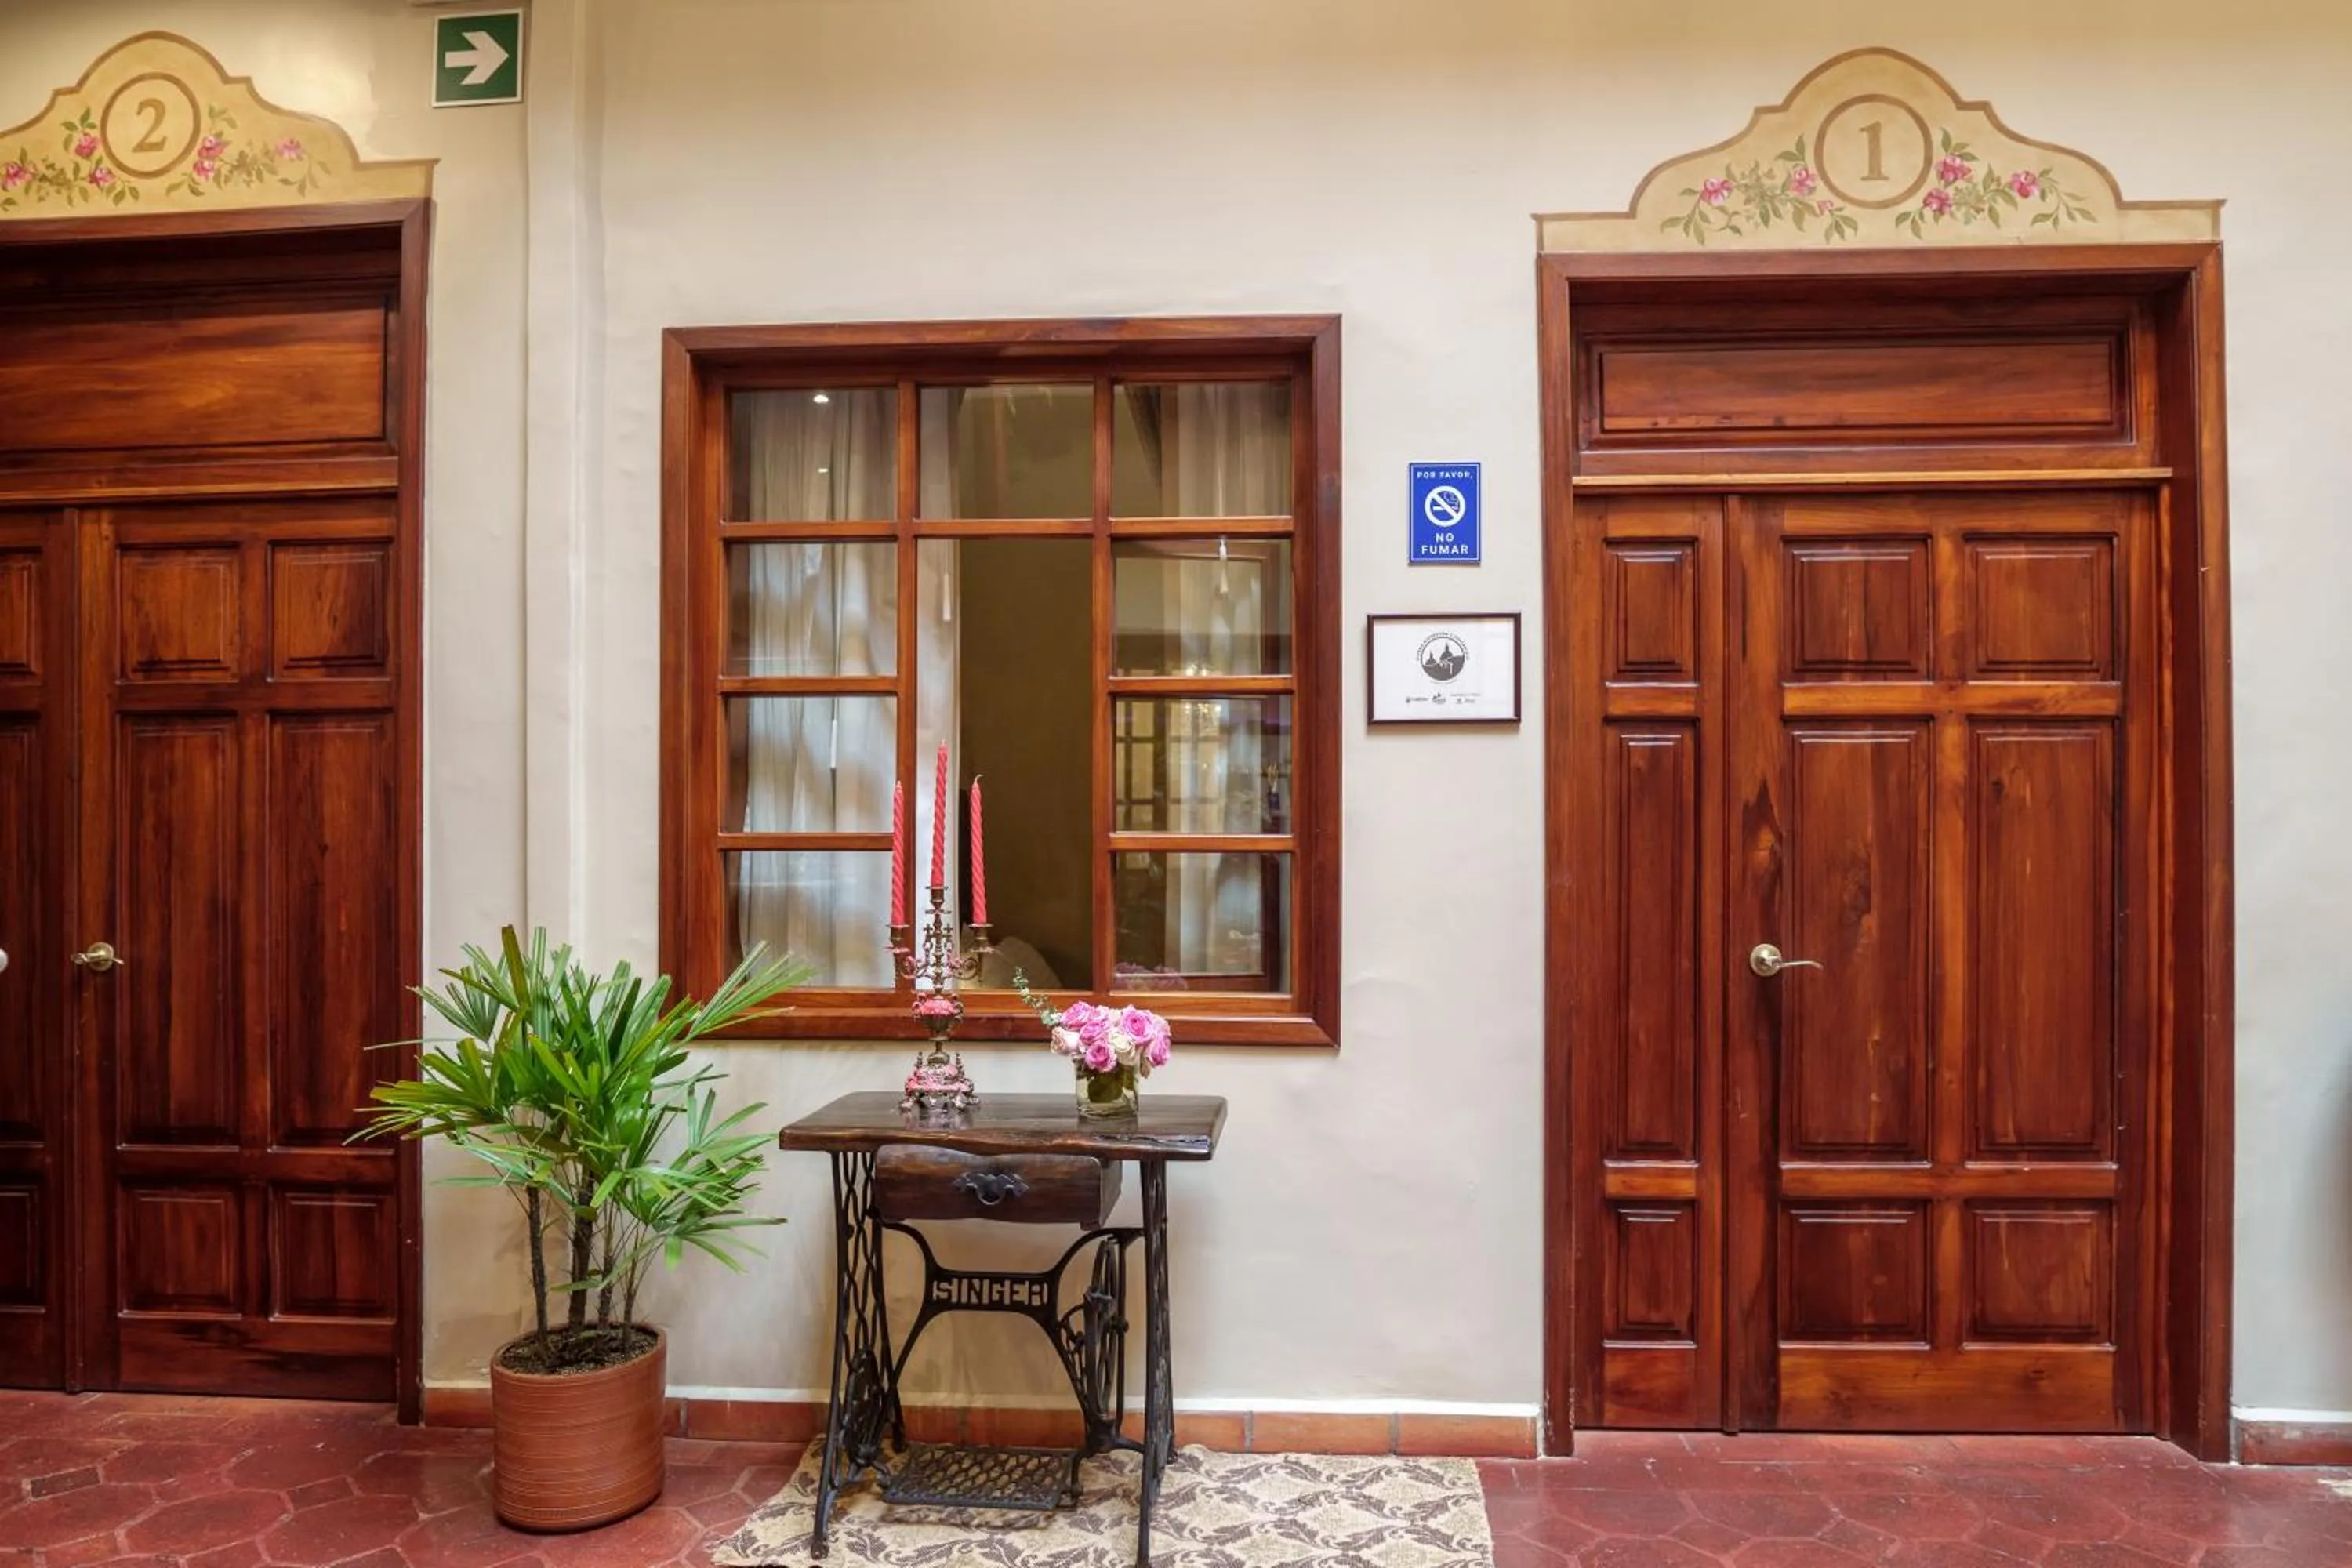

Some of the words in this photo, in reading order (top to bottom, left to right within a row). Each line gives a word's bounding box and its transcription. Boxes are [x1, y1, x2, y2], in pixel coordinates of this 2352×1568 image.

[132, 97, 168, 153] 2
[1859, 120, 1890, 181] 1
[1421, 545, 1468, 555] FUMAR
[1436, 532, 1454, 543] NO
[931, 1277, 1049, 1307] SINGER
